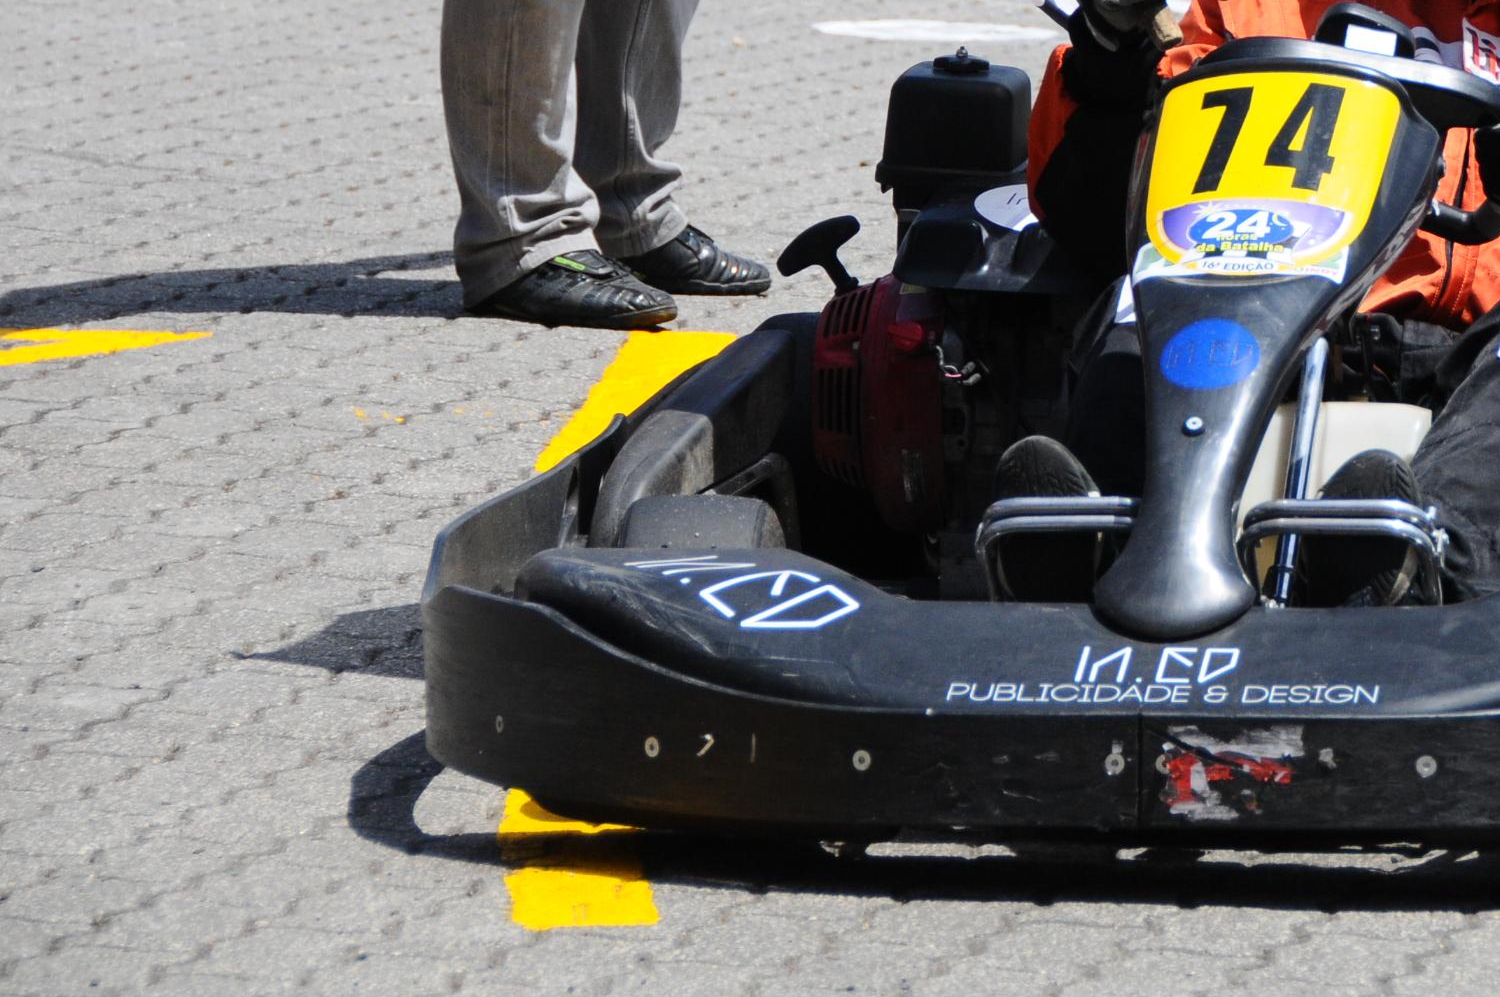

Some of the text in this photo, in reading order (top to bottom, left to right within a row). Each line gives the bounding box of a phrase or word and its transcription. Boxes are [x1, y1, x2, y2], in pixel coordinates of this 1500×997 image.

[1191, 83, 1346, 194] 74
[1202, 211, 1271, 239] 24
[946, 682, 1381, 705] PUBLICIDADE & DESIGN
